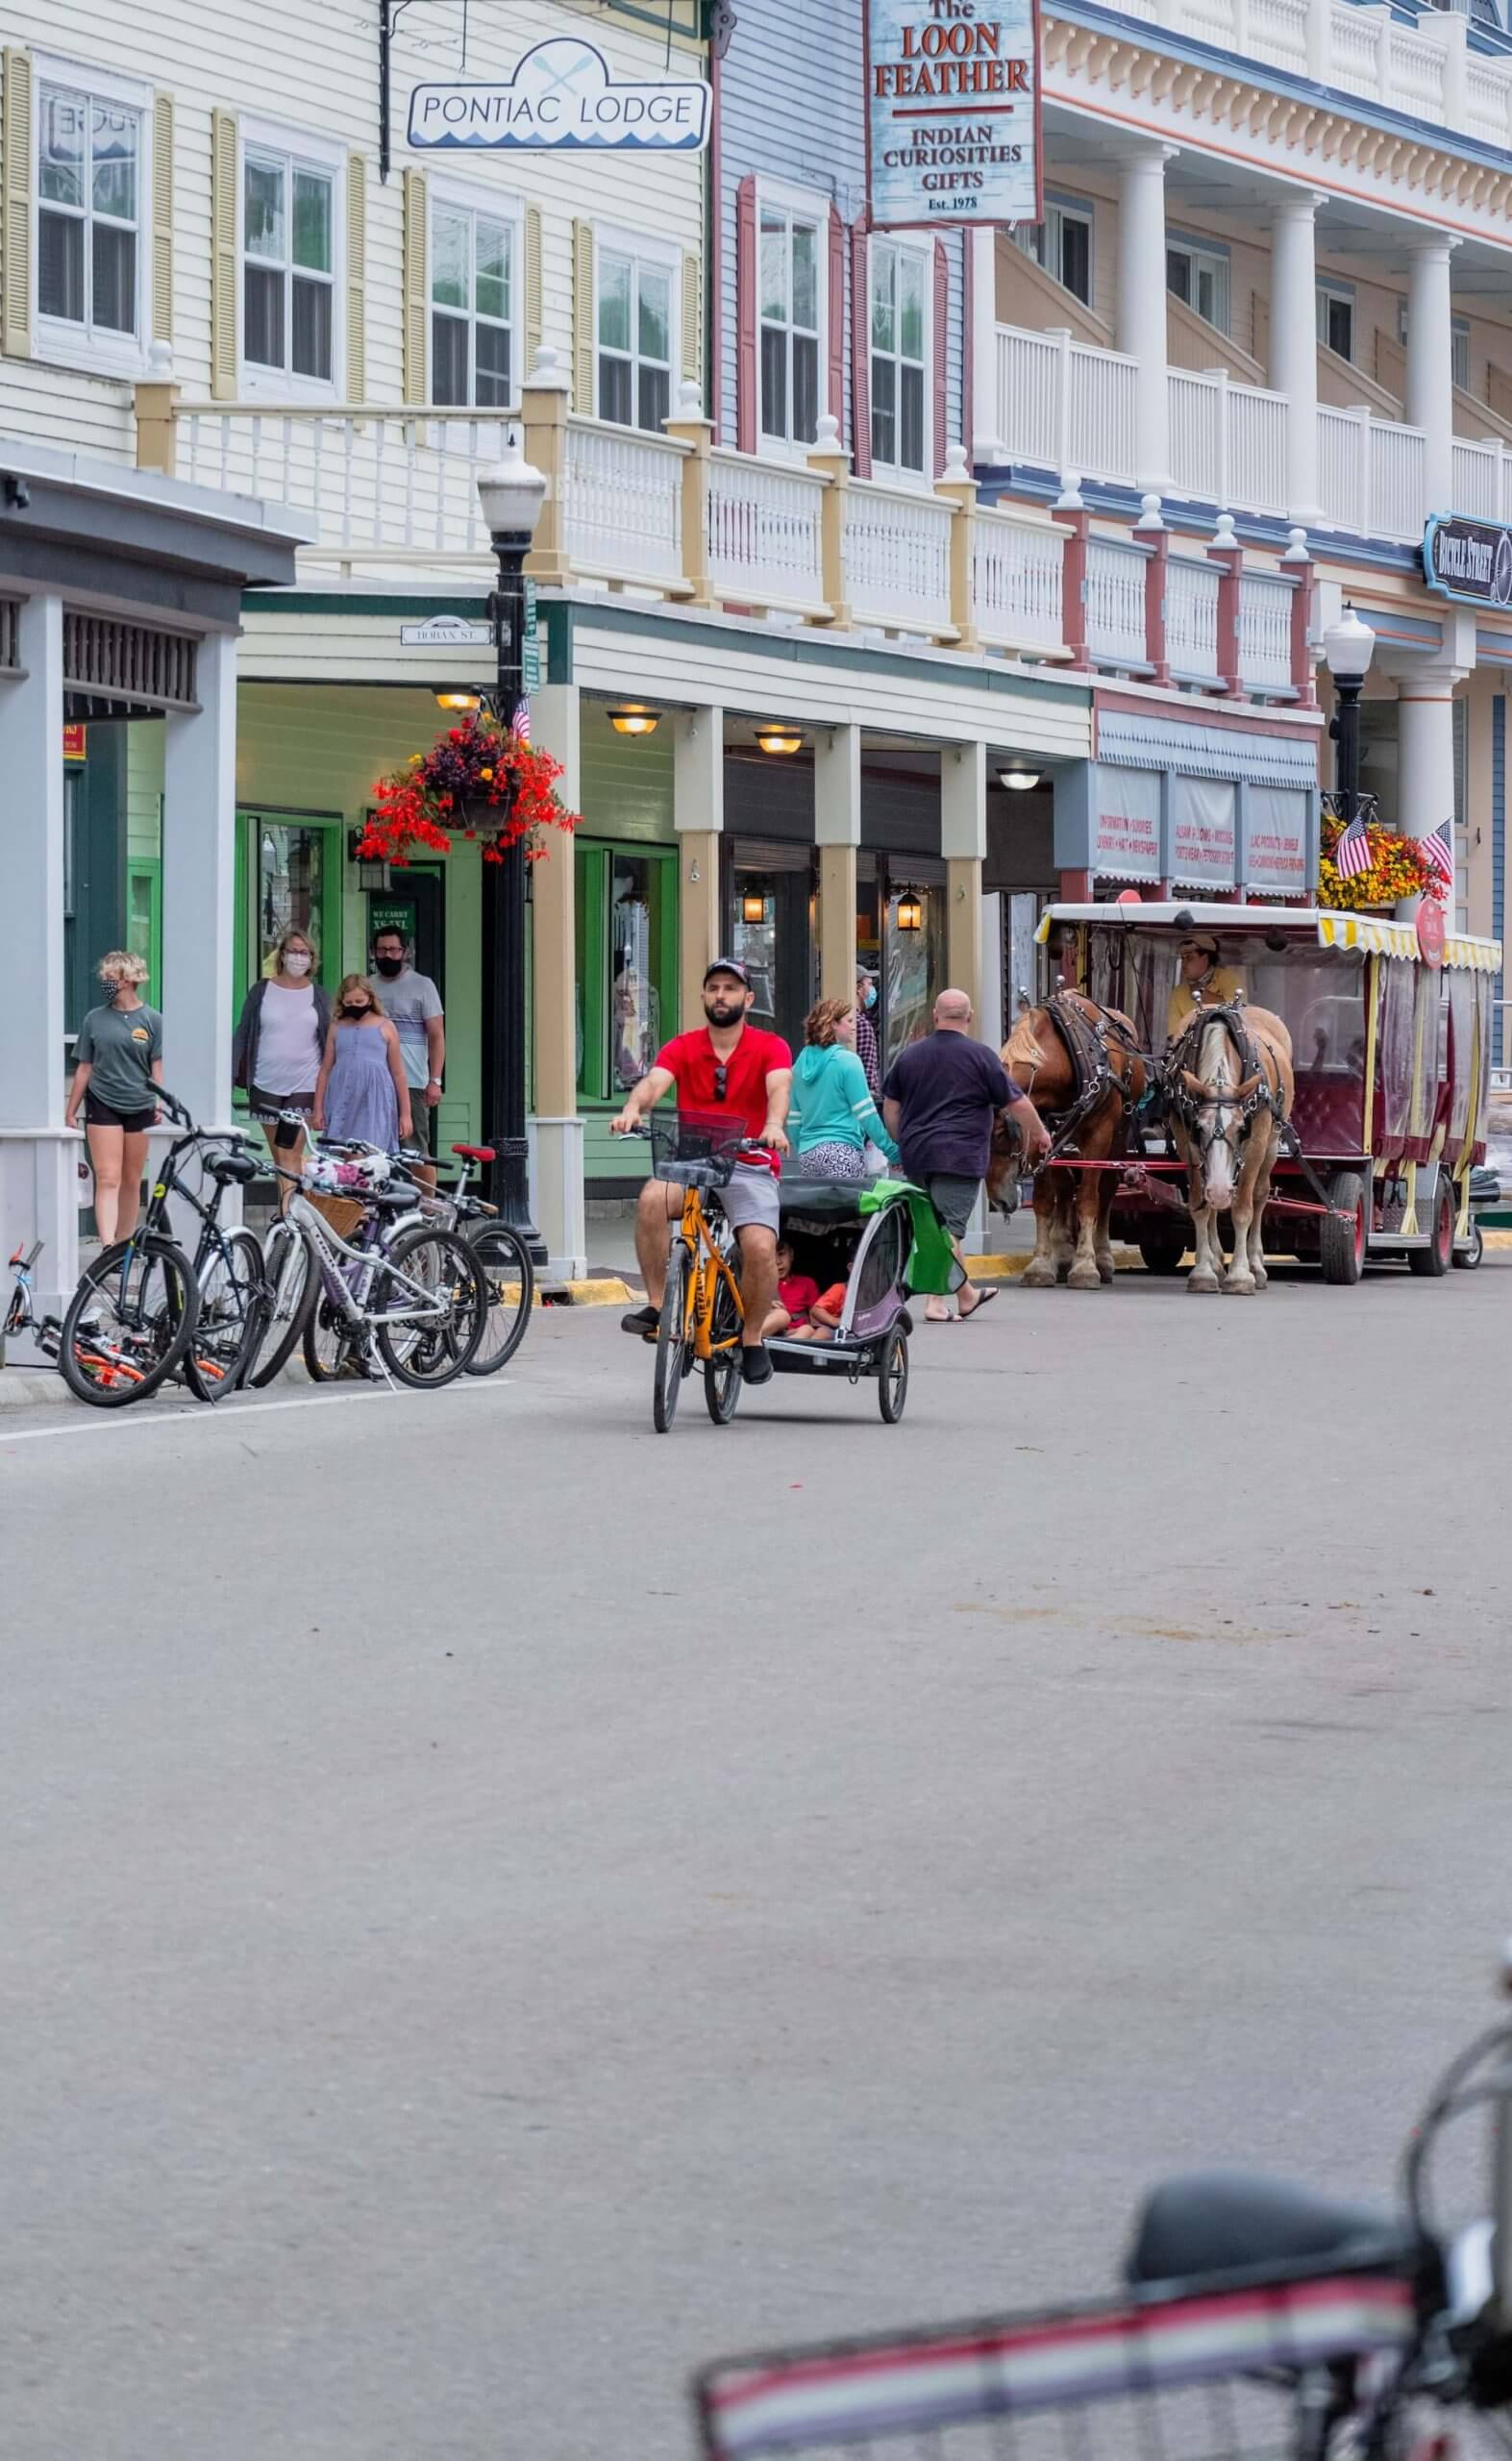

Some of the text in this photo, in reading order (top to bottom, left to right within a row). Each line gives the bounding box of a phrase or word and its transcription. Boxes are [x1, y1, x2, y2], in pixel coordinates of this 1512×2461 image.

[930, 0, 976, 18] The
[901, 22, 1001, 58] LOON
[874, 60, 1030, 97] FEATHER
[423, 96, 693, 124] PONTIAC LODGE
[912, 125, 993, 146] INDIAN
[883, 144, 1023, 168] CURIOSITIES
[922, 170, 983, 191] GIFTS
[929, 197, 978, 211] Est. 1978
[1438, 530, 1494, 584] BICYCLE STREET
